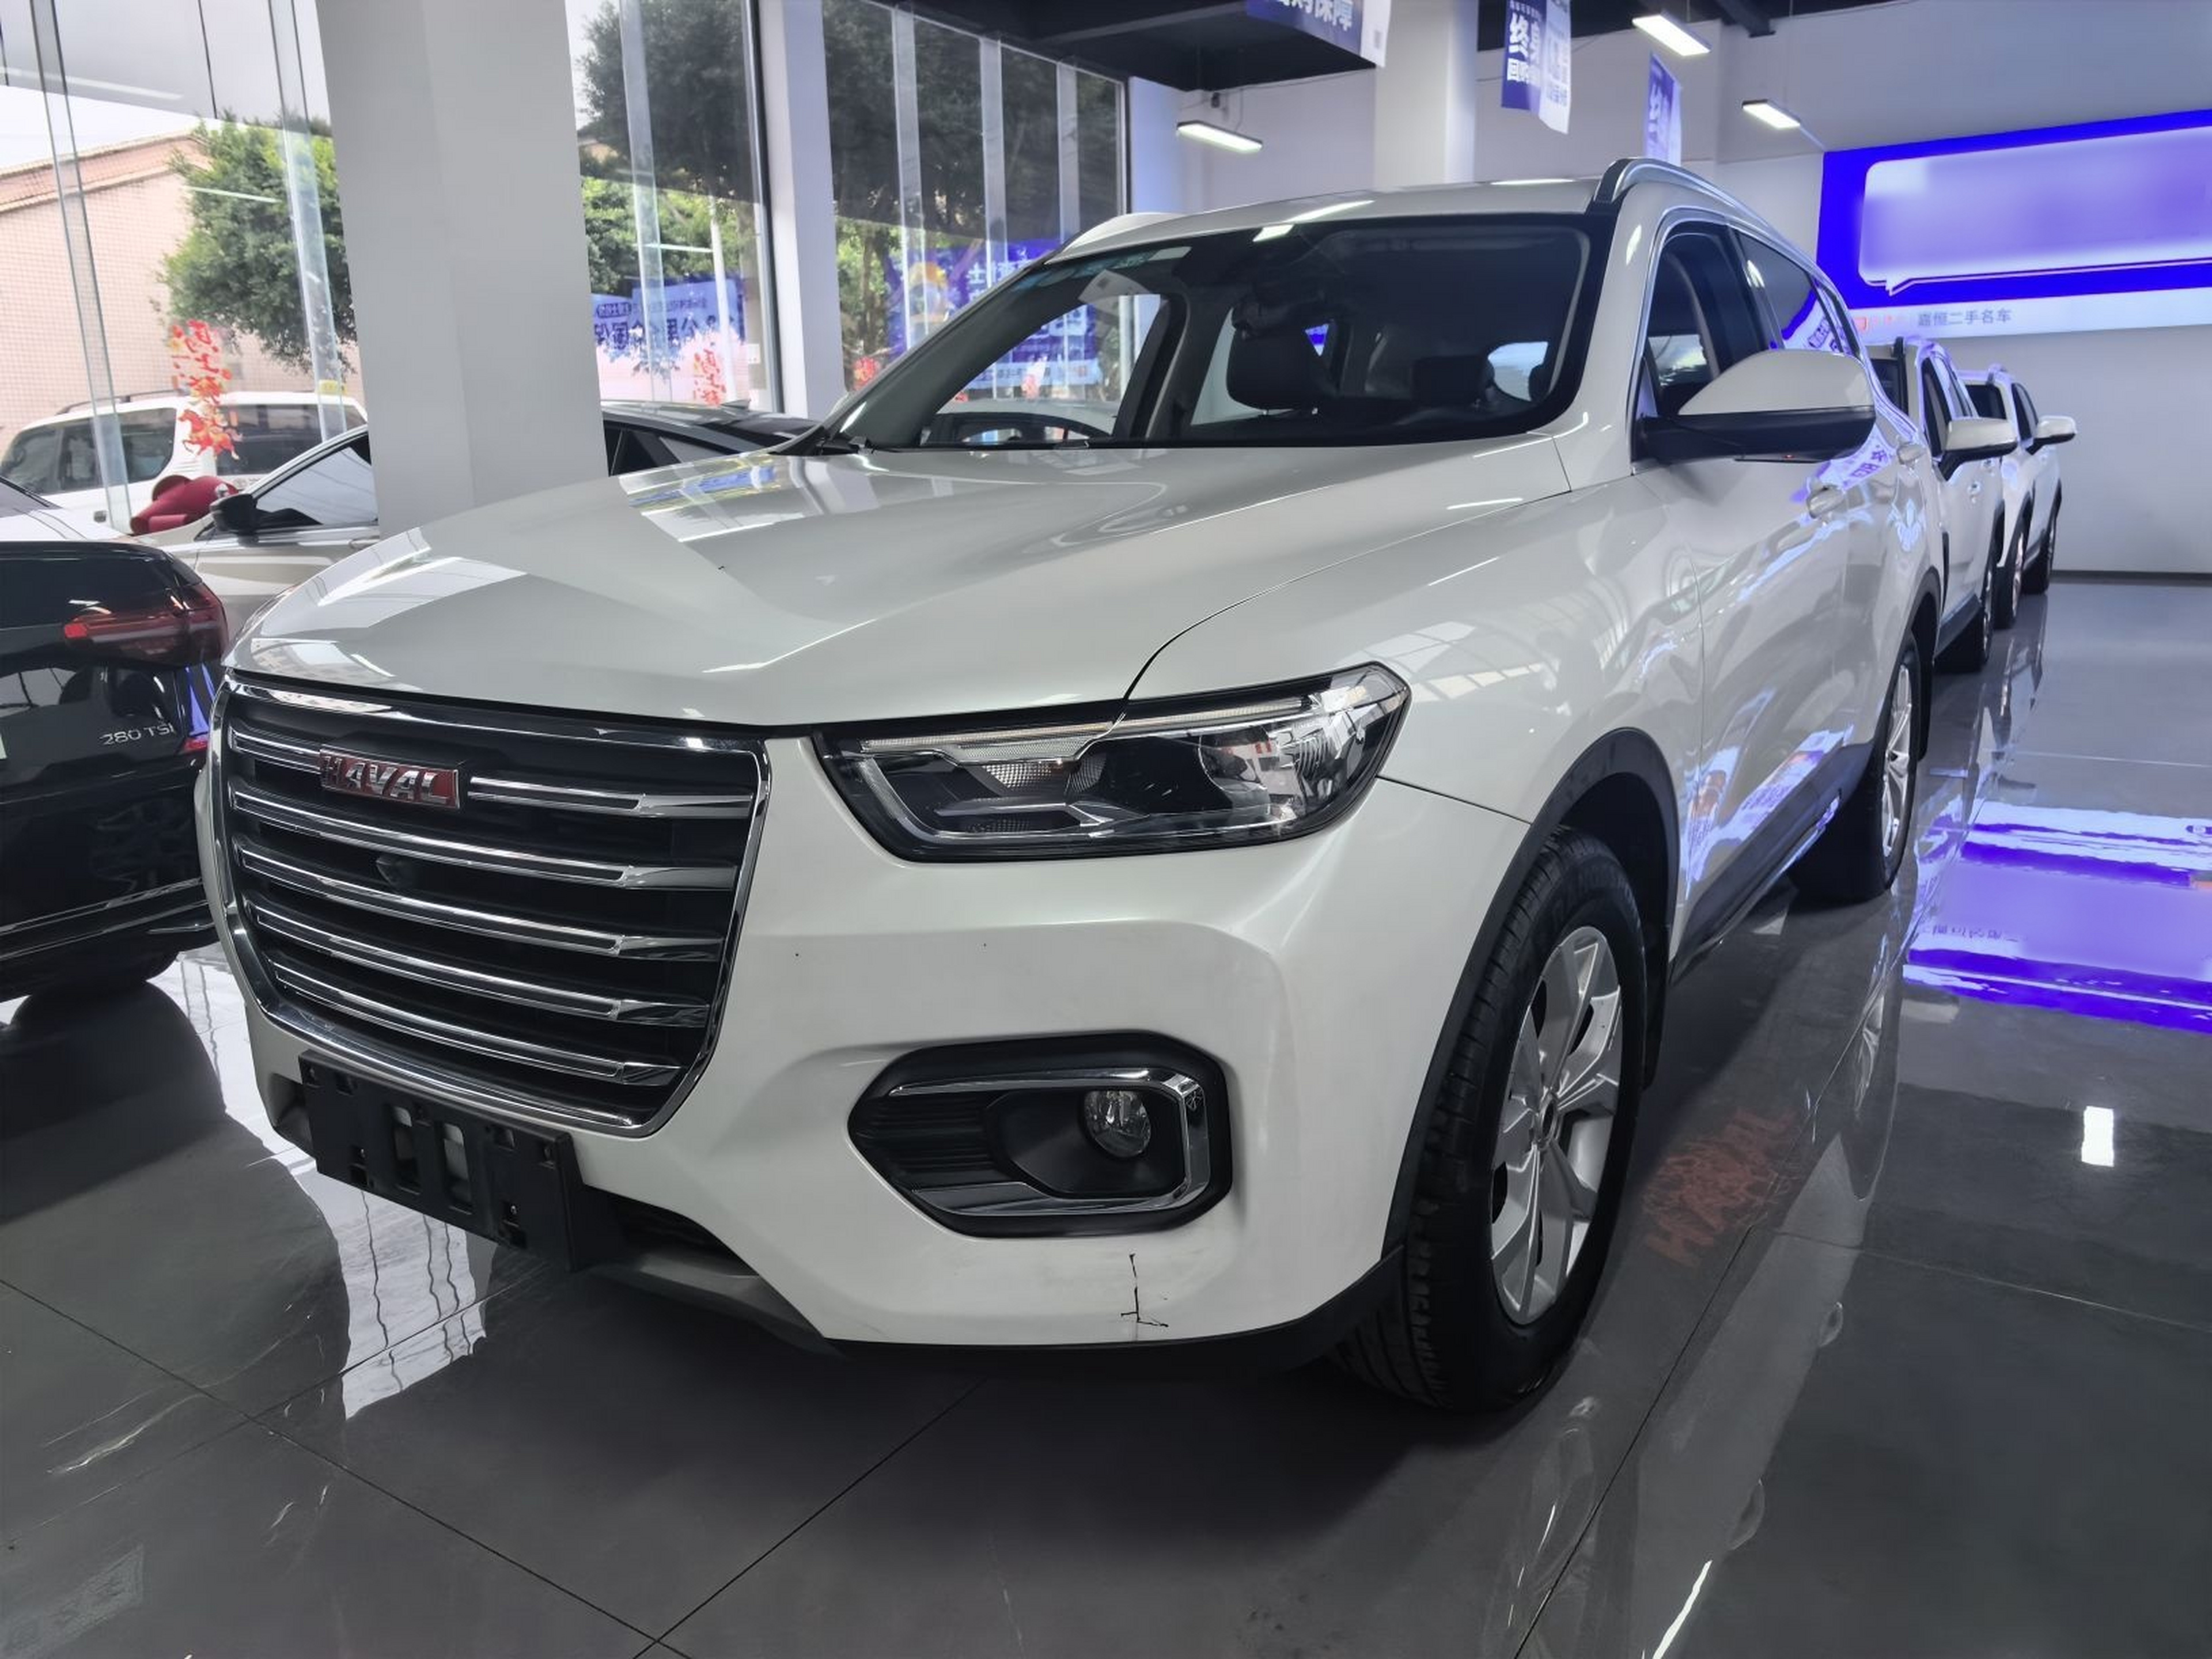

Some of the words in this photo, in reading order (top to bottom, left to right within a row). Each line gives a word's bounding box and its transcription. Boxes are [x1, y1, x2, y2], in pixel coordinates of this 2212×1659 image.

[99, 729, 142, 745] 280
[143, 723, 175, 736] TSI
[320, 755, 448, 804] HAVAL
